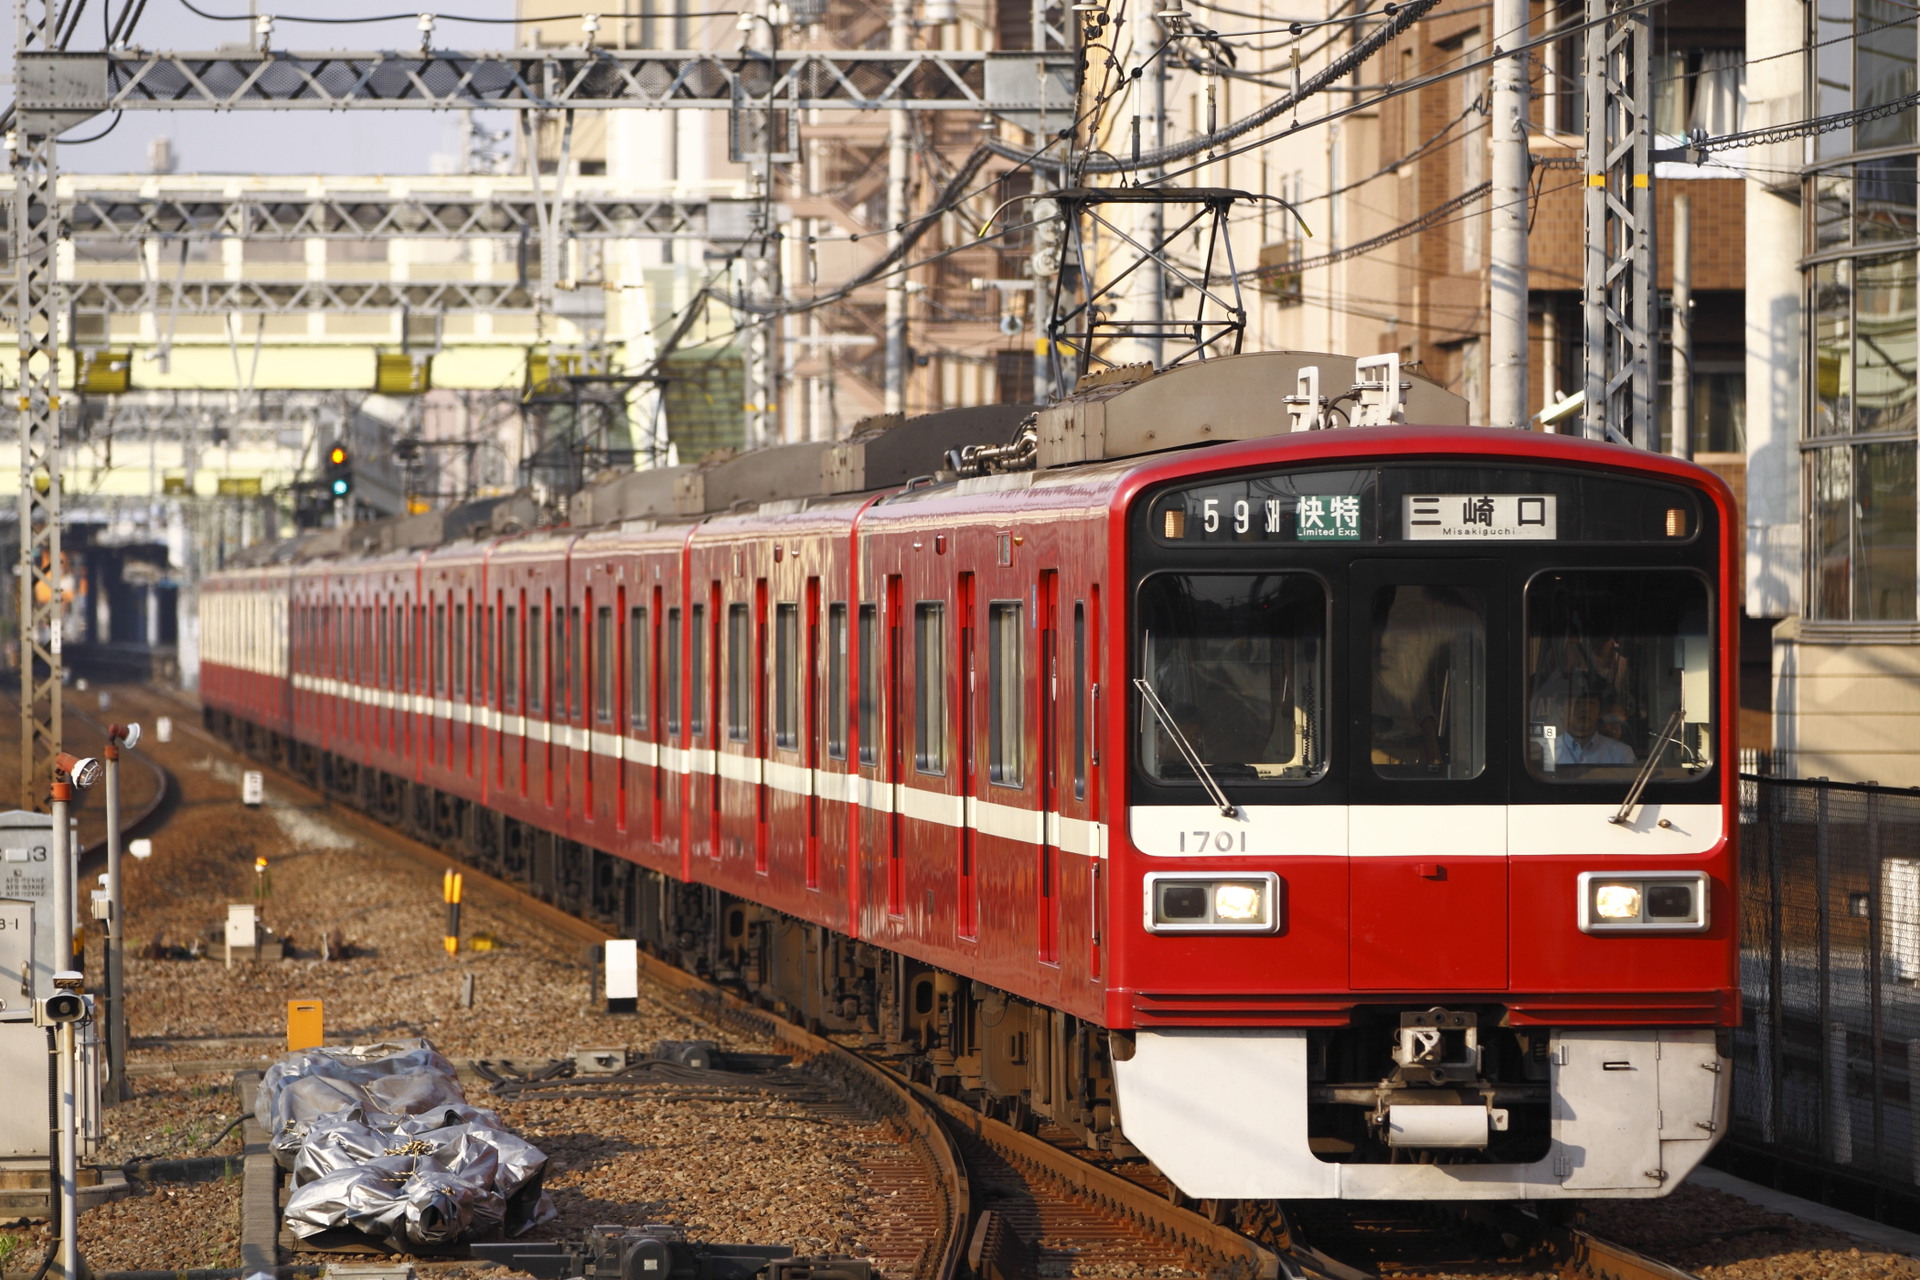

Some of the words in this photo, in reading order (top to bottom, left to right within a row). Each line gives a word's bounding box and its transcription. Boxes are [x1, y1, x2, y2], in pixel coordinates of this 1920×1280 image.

[1296, 495, 1360, 528] 快特
[1411, 495, 1546, 527] 三崎口
[1297, 527, 1335, 536] Limited
[1338, 527, 1359, 537] Exp.
[1442, 527, 1516, 537] Misakiguchi
[1179, 831, 1246, 852] 1701
[33, 846, 47, 862] 3
